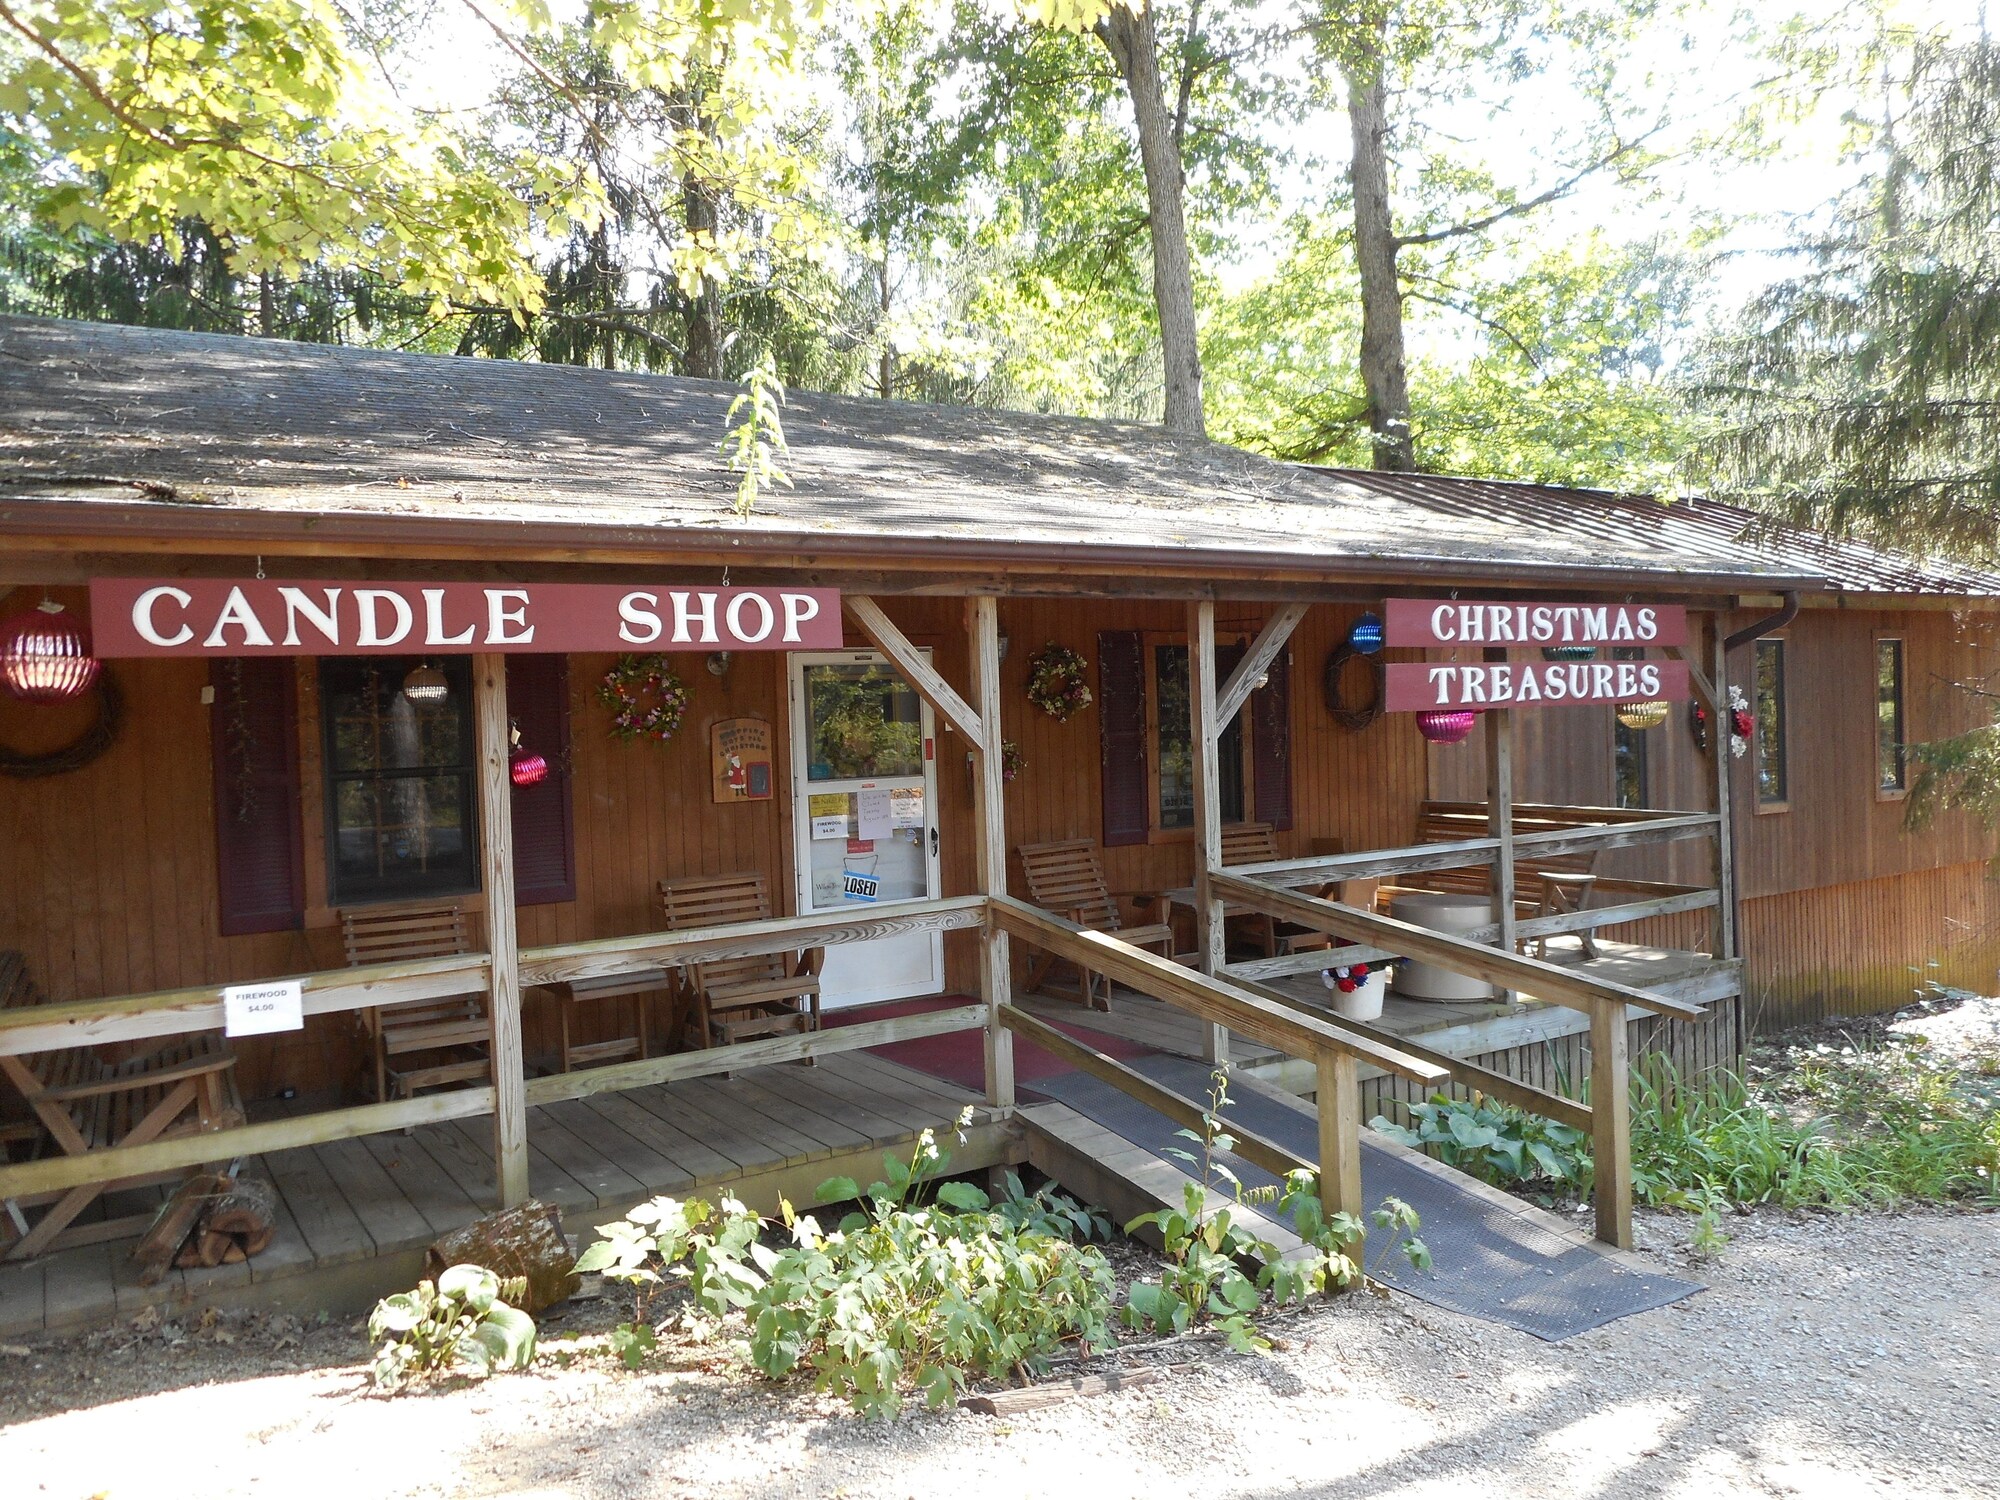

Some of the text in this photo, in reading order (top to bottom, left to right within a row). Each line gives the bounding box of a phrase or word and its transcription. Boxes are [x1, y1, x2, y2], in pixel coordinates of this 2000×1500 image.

[131, 585, 820, 648] CANDLE SHOP
[1431, 604, 1658, 642] CHRISTMAS
[1428, 664, 1661, 705] TREASURES
[236, 990, 287, 1000] FIREWOOD
[248, 1004, 274, 1012] $4.00
